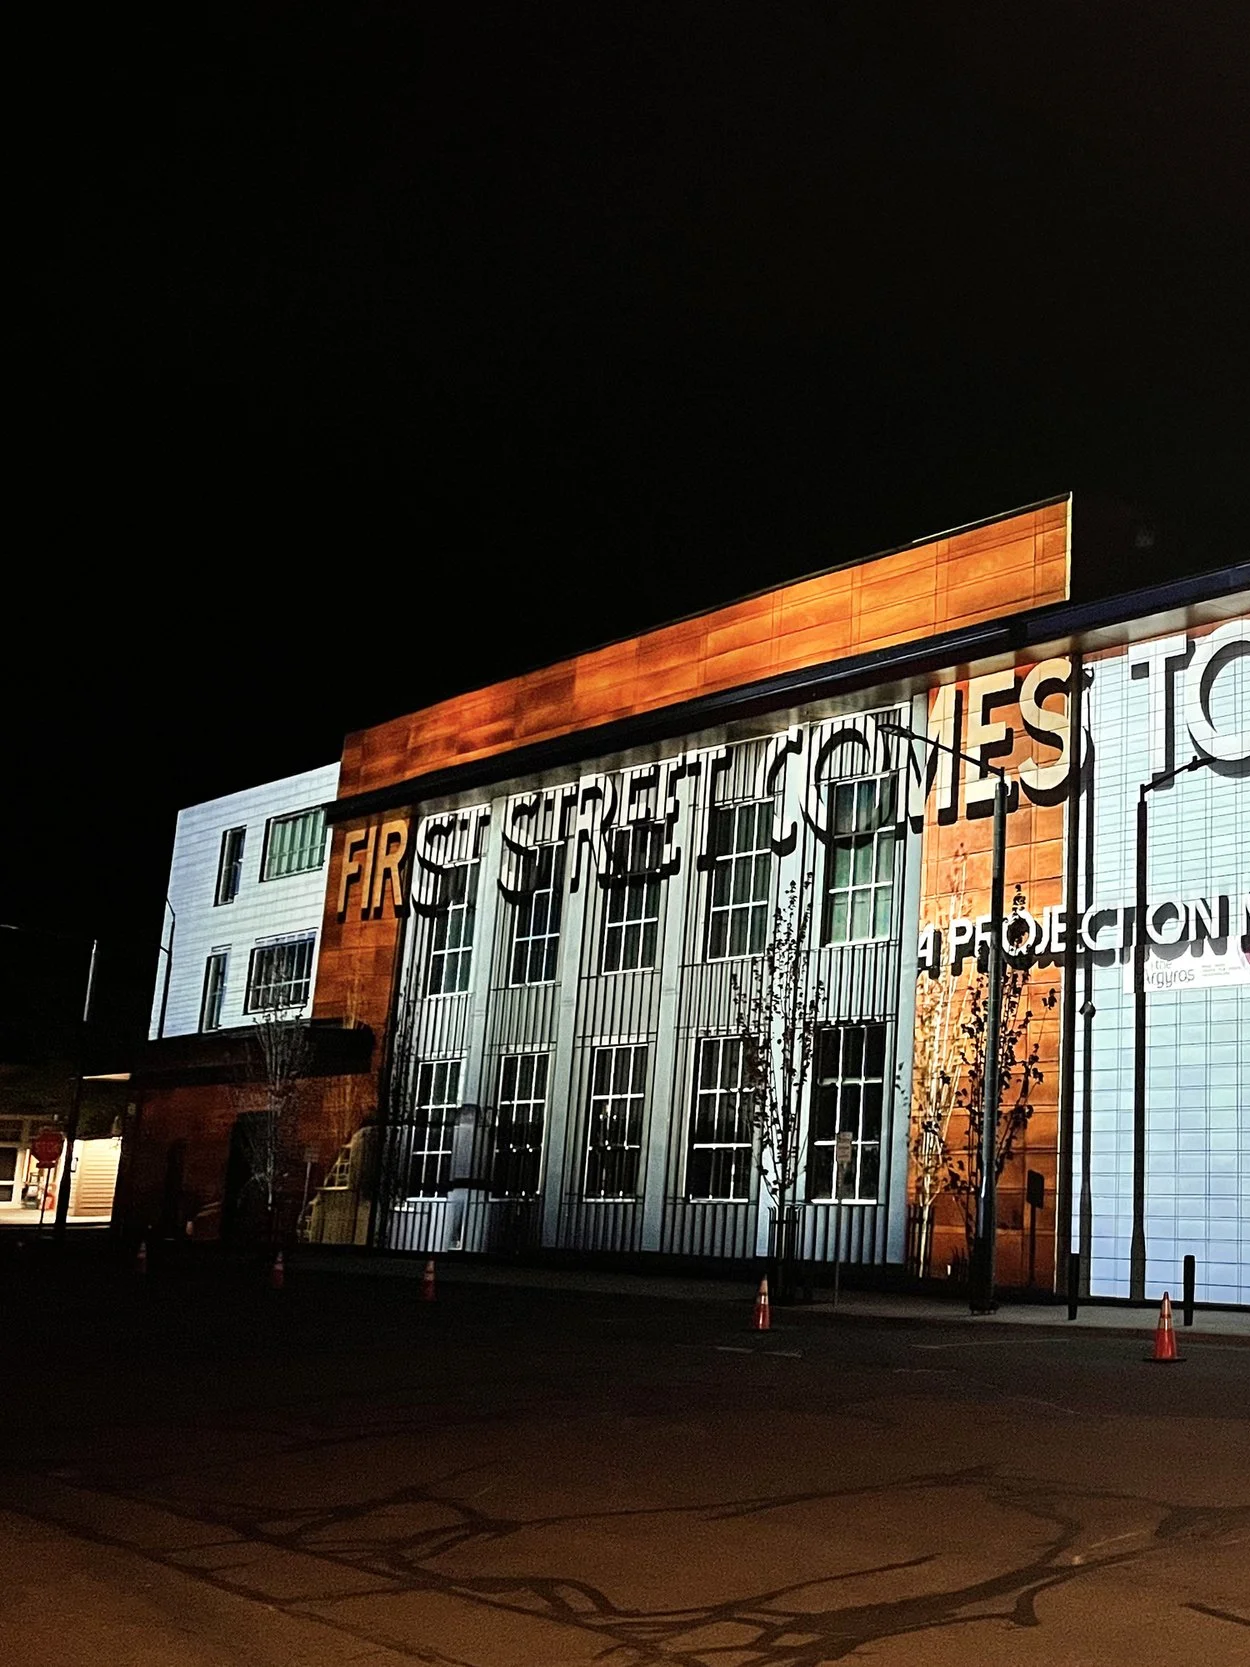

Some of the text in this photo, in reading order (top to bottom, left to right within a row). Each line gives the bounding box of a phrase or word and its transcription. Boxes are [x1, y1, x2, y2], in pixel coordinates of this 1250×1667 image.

[338, 803, 492, 918] FIRST
[498, 746, 732, 902] STREET
[757, 658, 1092, 854] COMES
[917, 922, 939, 973] A
[949, 896, 1228, 968] PROJECTON
